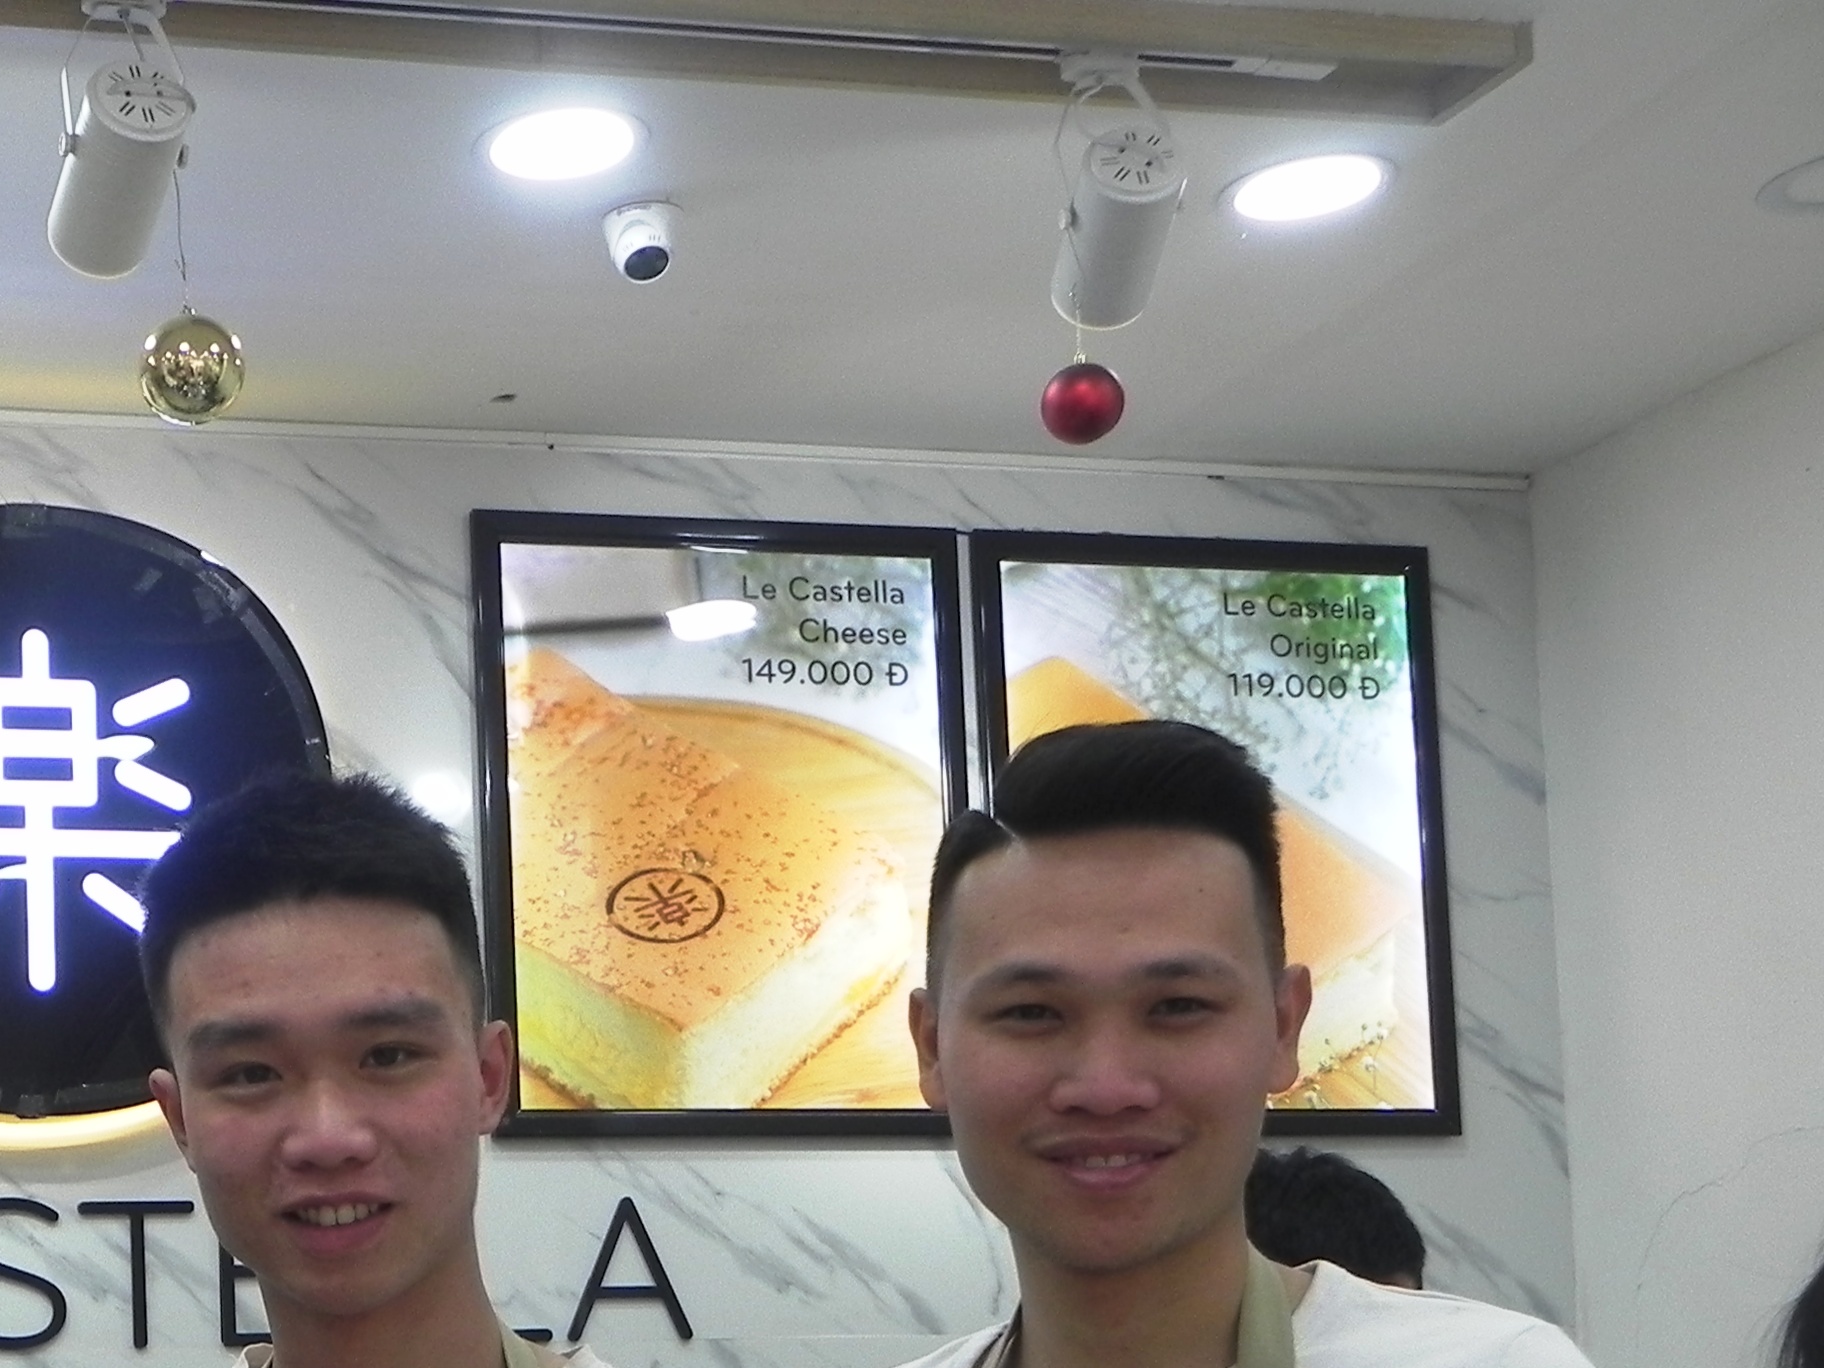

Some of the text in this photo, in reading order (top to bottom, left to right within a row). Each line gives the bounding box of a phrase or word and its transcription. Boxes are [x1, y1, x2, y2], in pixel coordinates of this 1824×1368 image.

[742, 575, 905, 605] Le Castella
[1223, 592, 1376, 621] Le Castella
[798, 618, 907, 646] Cheese
[1270, 633, 1379, 665] Original
[741, 658, 874, 686] 149.000
[1227, 673, 1347, 700] 119.000
